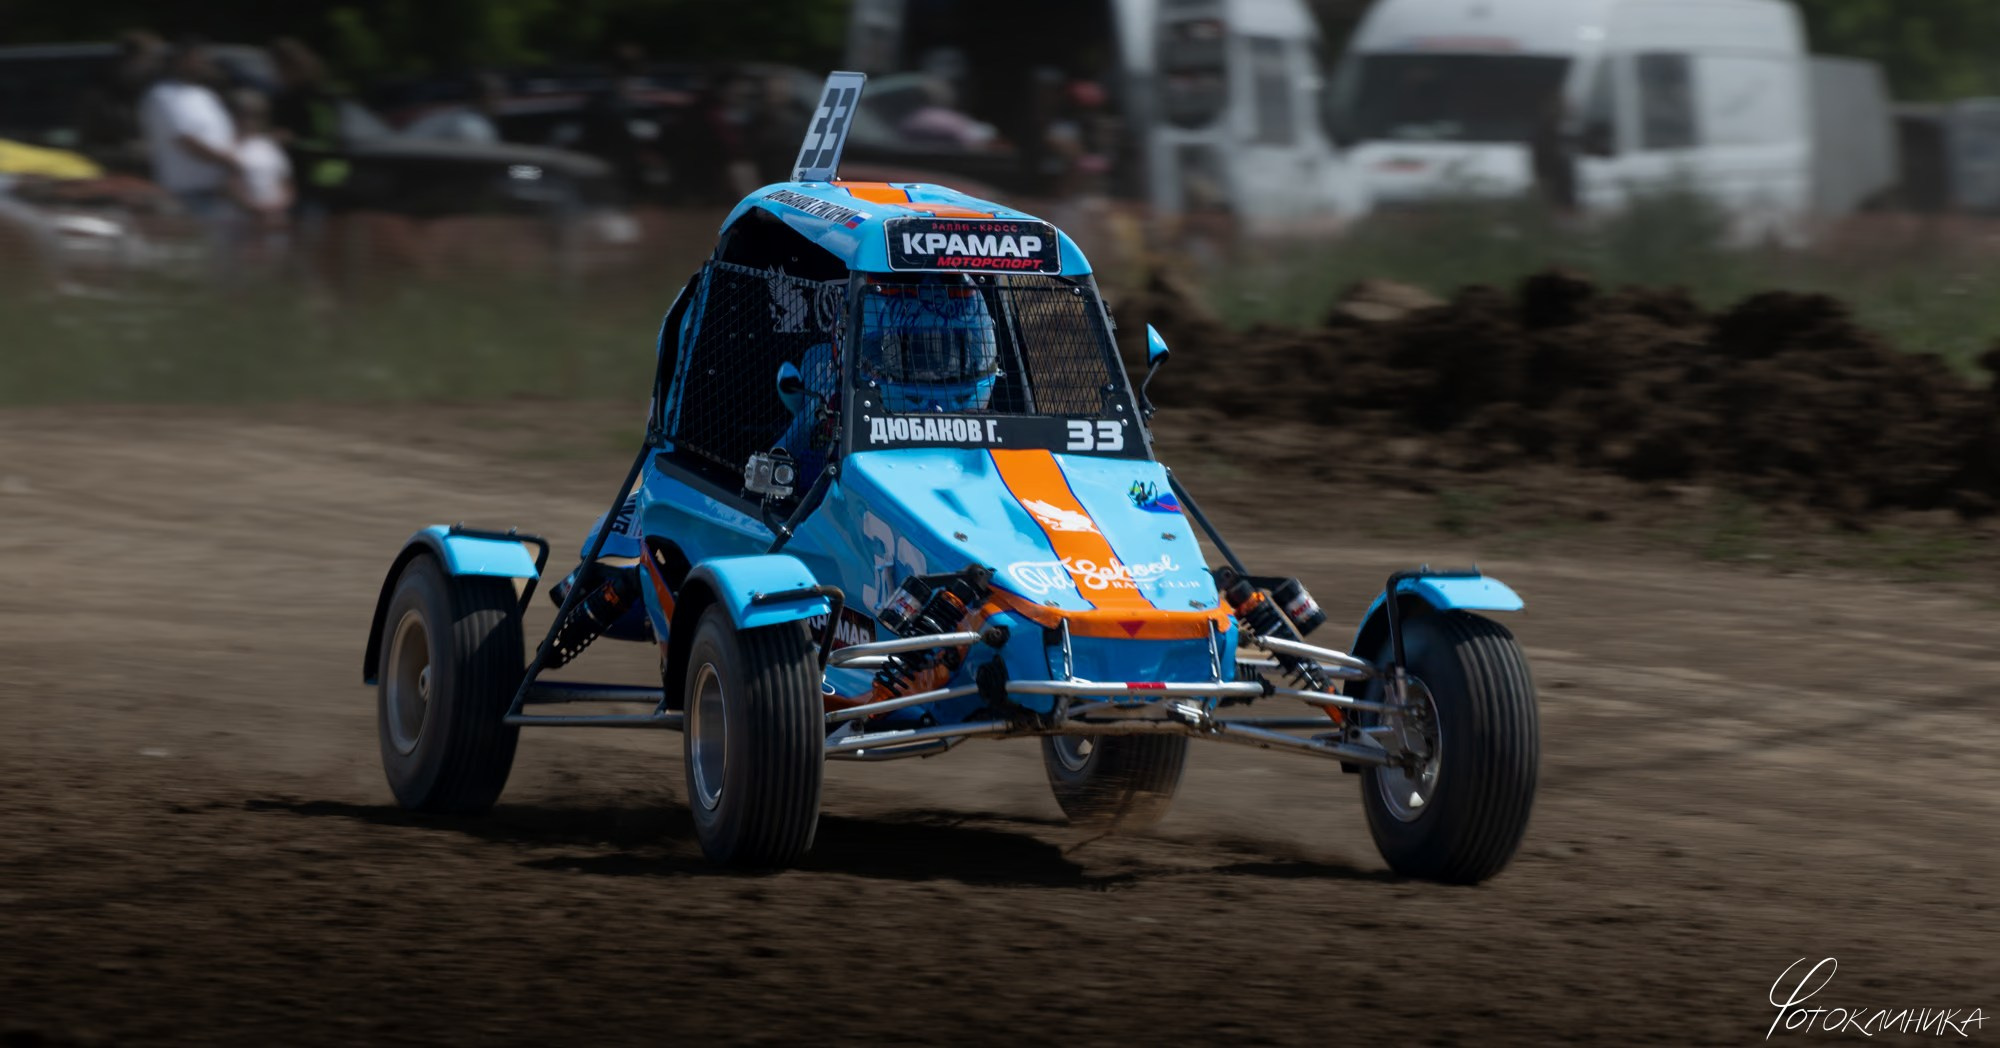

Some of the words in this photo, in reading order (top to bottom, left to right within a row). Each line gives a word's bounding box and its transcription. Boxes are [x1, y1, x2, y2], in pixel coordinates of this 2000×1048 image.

[799, 88, 856, 168] 33
[902, 233, 1042, 257] КРАМАР
[937, 256, 1044, 269] МОТОРСПОРТ
[870, 417, 982, 444] ДЮБАКОВ
[987, 420, 1003, 443] Г.
[1066, 420, 1123, 451] 33
[1008, 556, 1075, 595] Old
[1064, 553, 1180, 590] School
